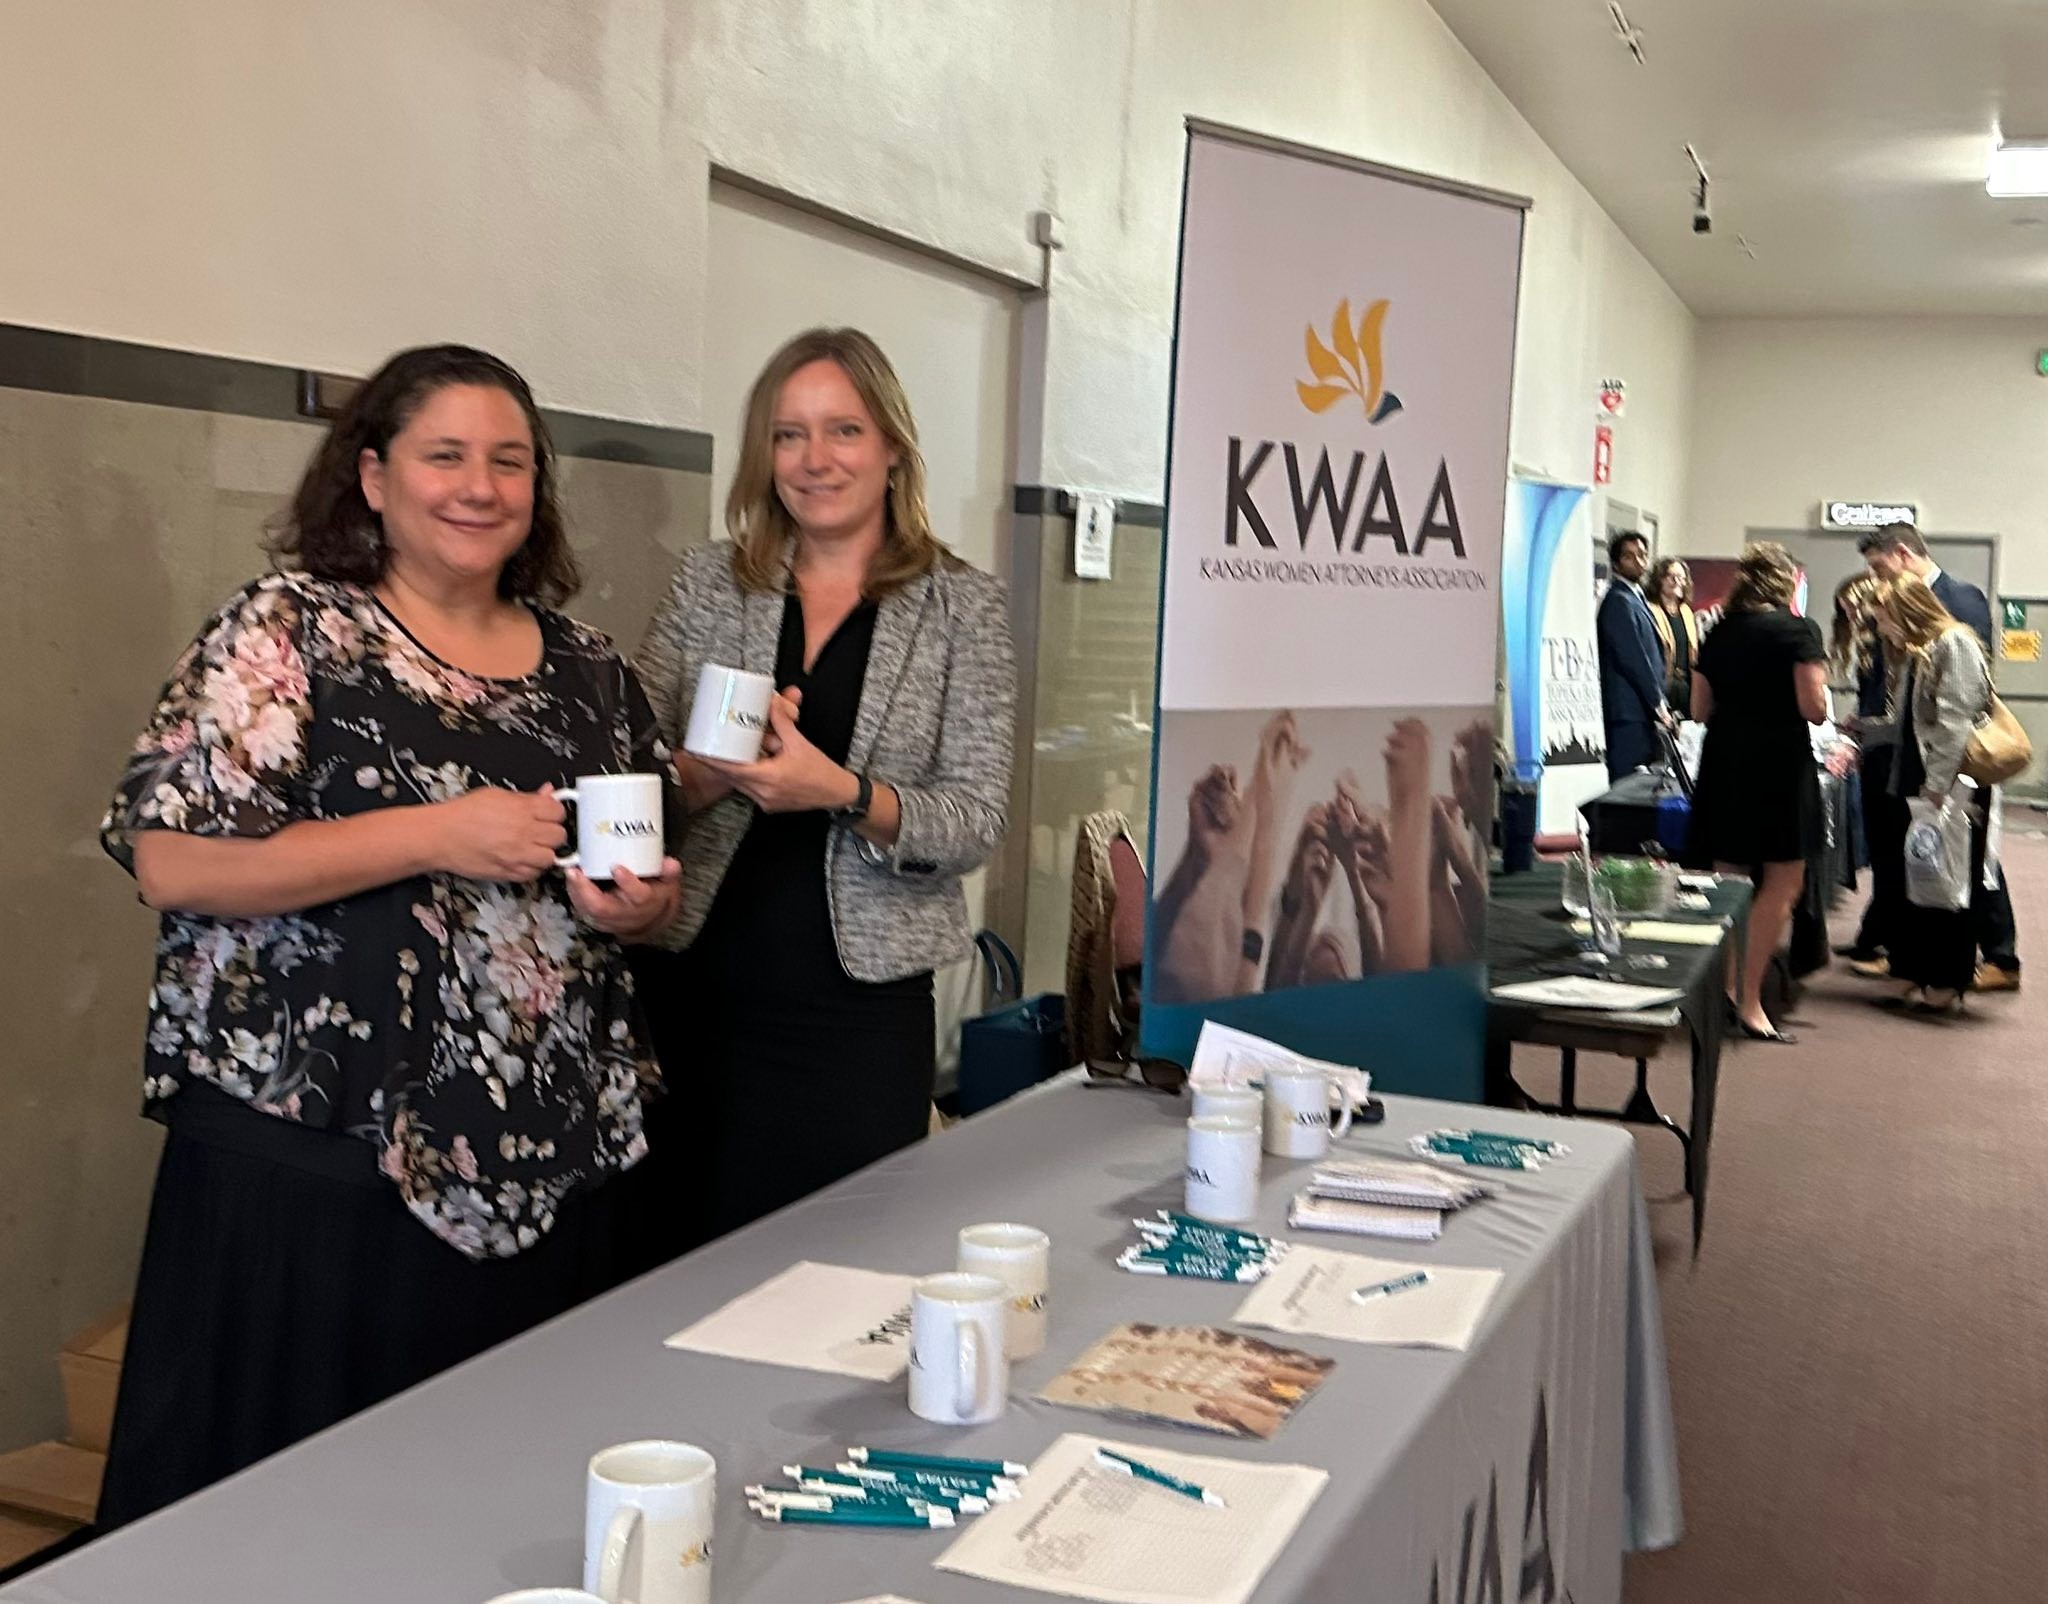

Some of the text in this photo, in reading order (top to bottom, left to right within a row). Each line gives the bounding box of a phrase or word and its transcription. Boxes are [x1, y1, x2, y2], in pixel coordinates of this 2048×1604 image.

[1225, 436, 1467, 559] KWAA
[1200, 557, 1261, 582] KANSAS
[1263, 559, 1321, 585] WOMEN
[613, 819, 656, 837] KWAA
